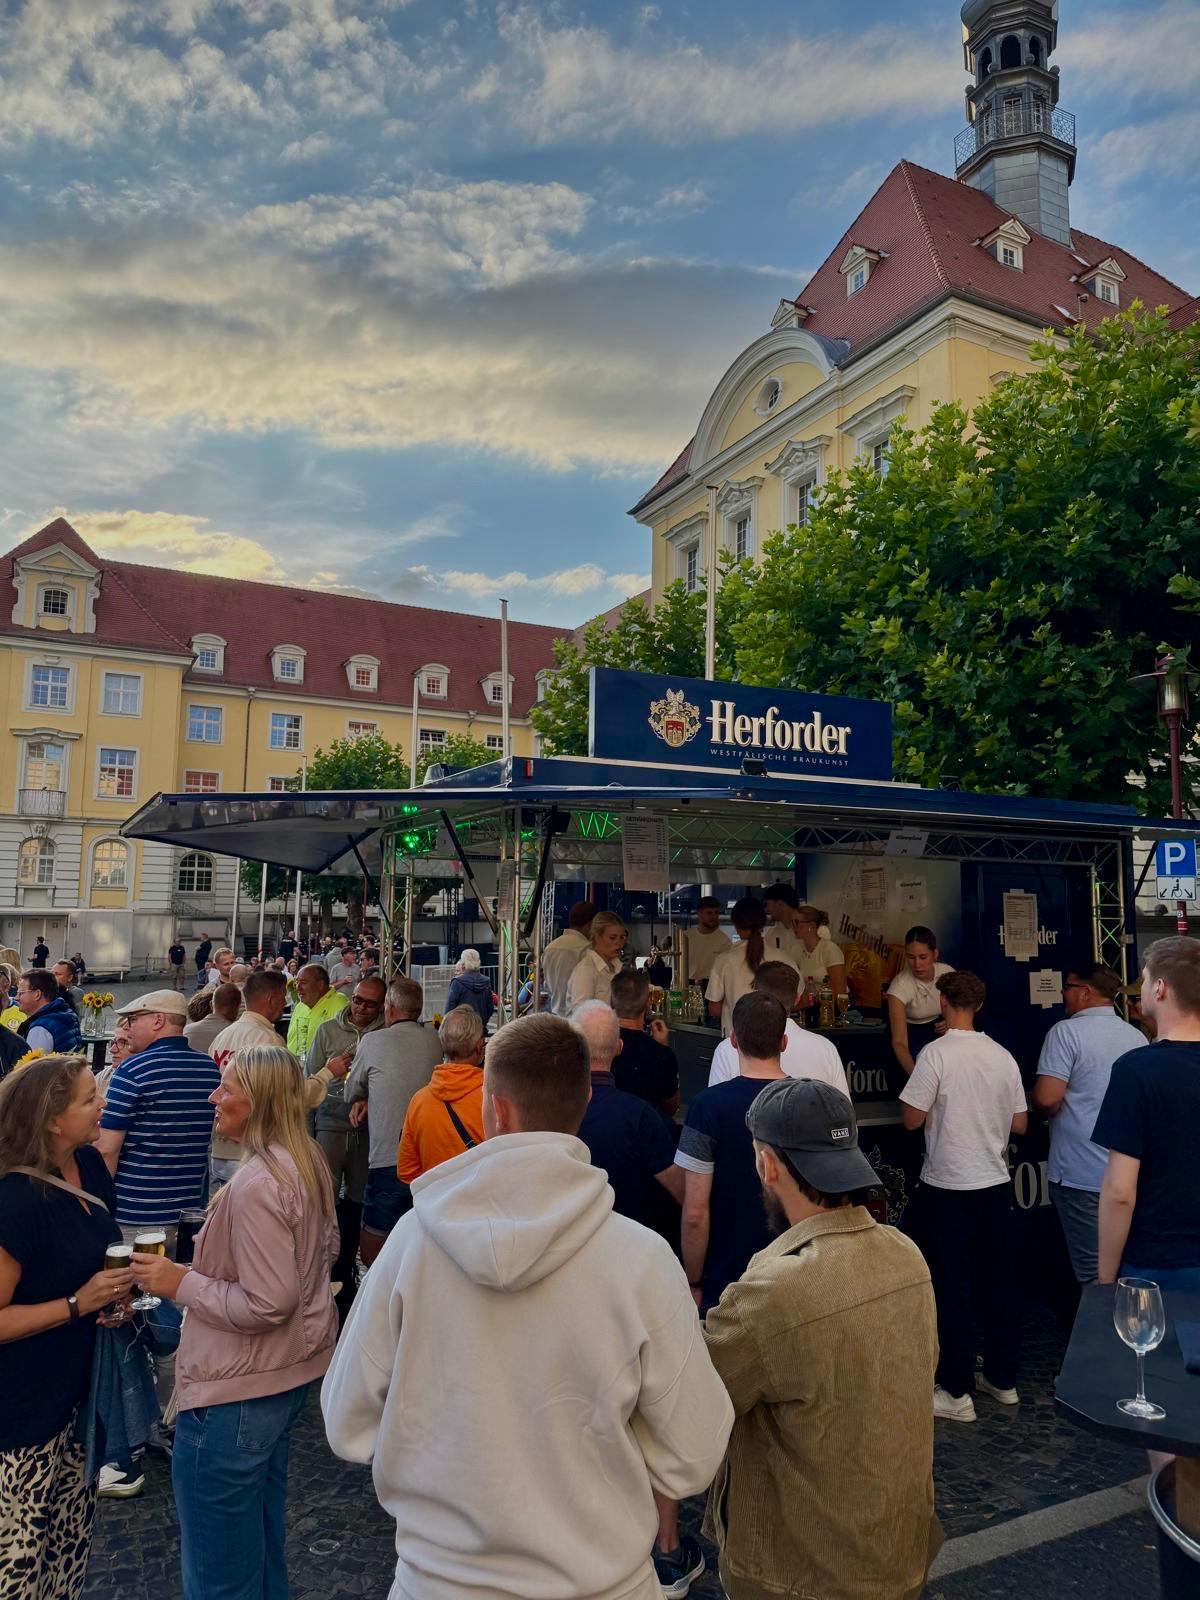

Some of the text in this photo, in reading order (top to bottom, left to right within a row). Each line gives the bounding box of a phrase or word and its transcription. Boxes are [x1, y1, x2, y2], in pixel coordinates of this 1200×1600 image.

[705, 699, 851, 756] Herforder
[710, 749, 849, 767] WESTFÄLISCHE BRAUKUNST
[1164, 842, 1186, 875] P
